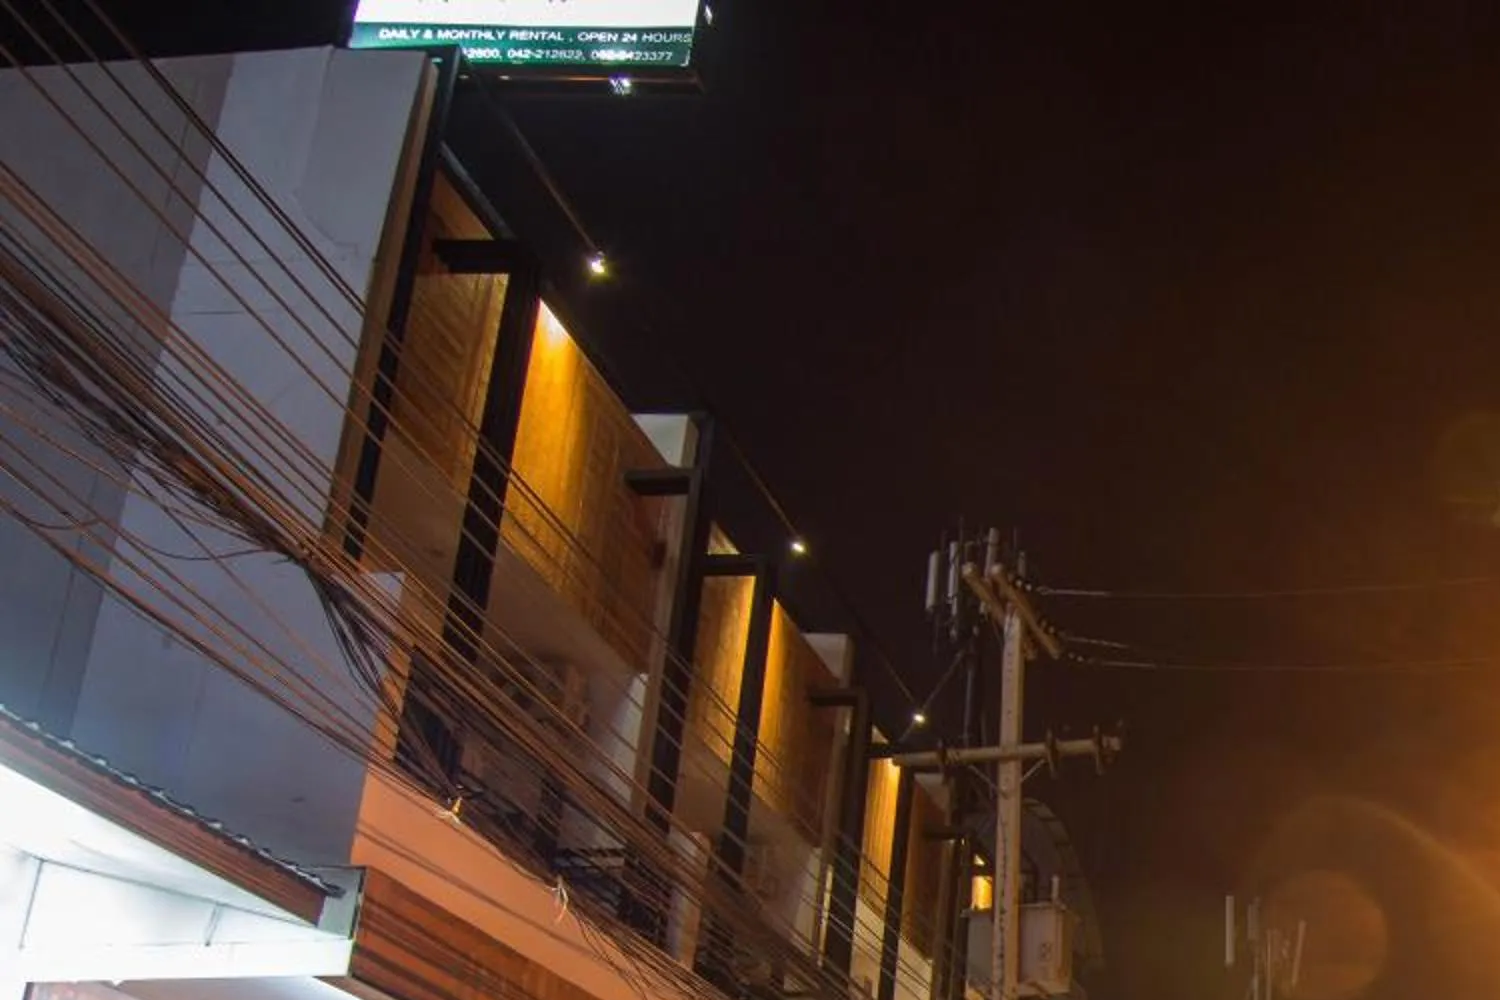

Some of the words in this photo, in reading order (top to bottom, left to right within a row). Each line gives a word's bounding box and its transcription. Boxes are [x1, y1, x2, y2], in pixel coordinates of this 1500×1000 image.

[379, 28, 421, 40] DAILY
[436, 29, 505, 40] MONTHLY
[509, 30, 565, 41] RENTAL
[577, 31, 619, 43] OPEN
[621, 32, 638, 43] 24
[641, 32, 692, 43] HOURS
